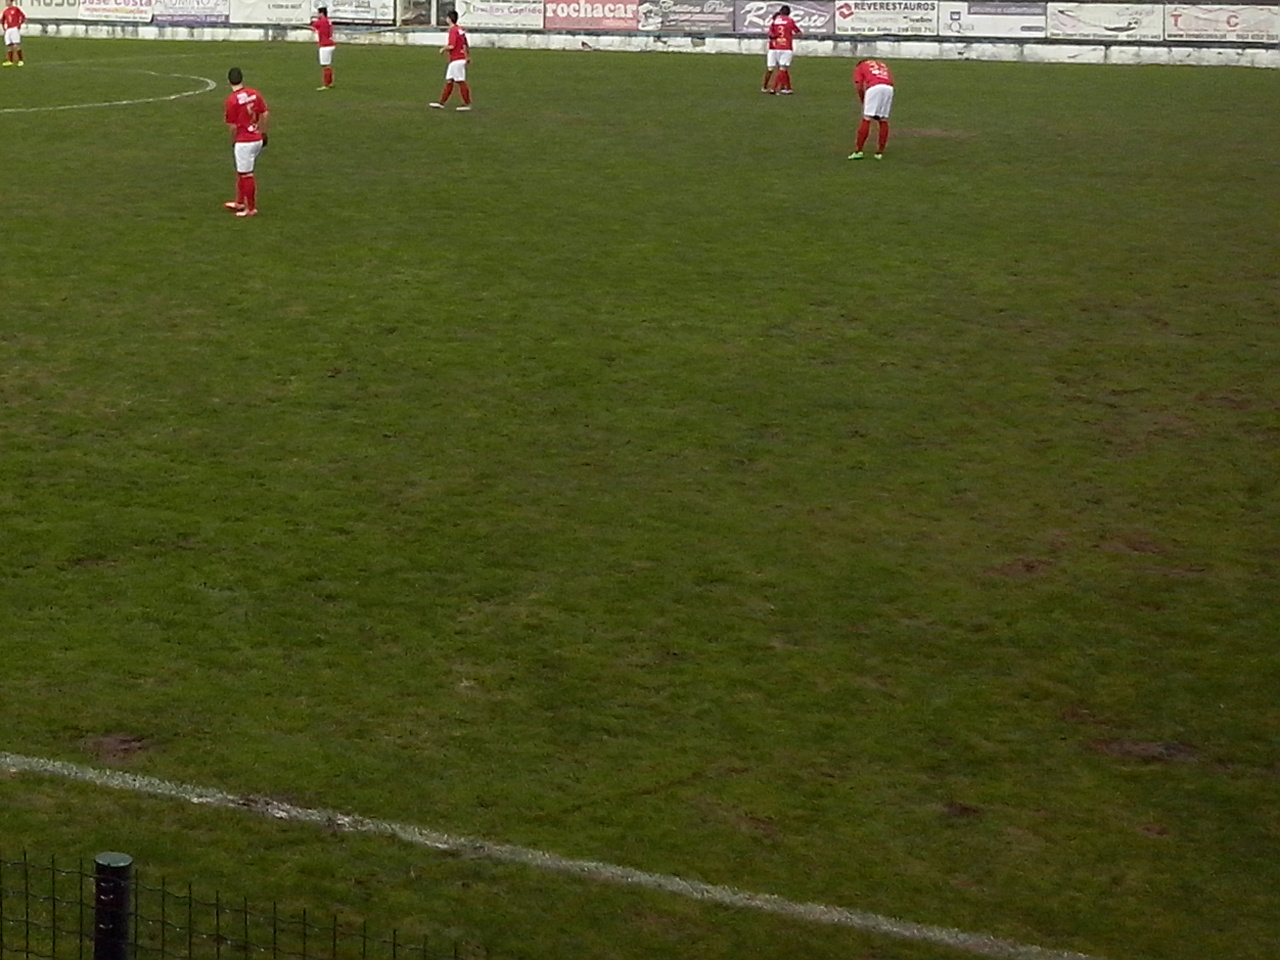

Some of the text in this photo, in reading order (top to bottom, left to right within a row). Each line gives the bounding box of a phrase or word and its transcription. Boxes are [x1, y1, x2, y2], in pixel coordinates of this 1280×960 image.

[546, 0, 637, 18] rochacar
[854, 2, 936, 11] REVERESTAUROS
[1170, 14, 1239, 28] T C
